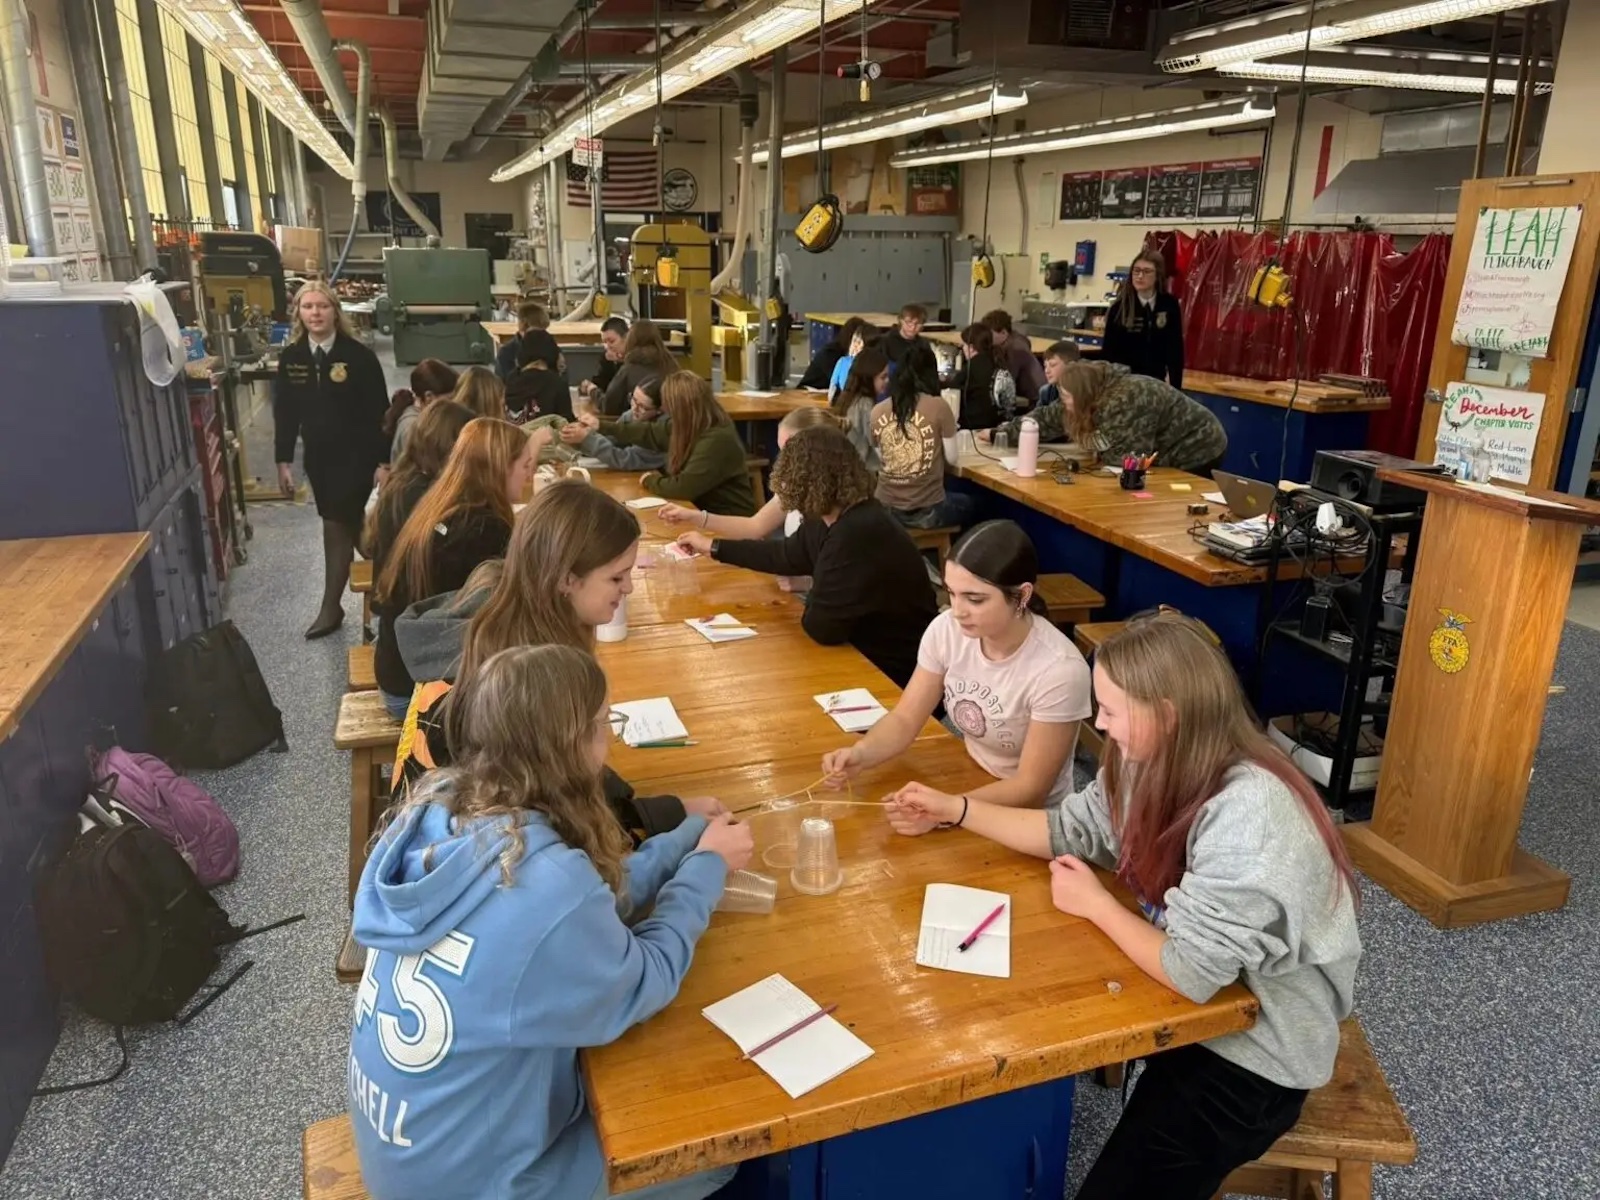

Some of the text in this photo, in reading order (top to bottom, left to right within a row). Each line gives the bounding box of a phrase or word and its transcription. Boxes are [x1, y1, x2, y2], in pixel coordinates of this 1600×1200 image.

[1486, 207, 1567, 257] LEAH
[1460, 397, 1535, 419] December
[1487, 439, 1504, 450] Red
